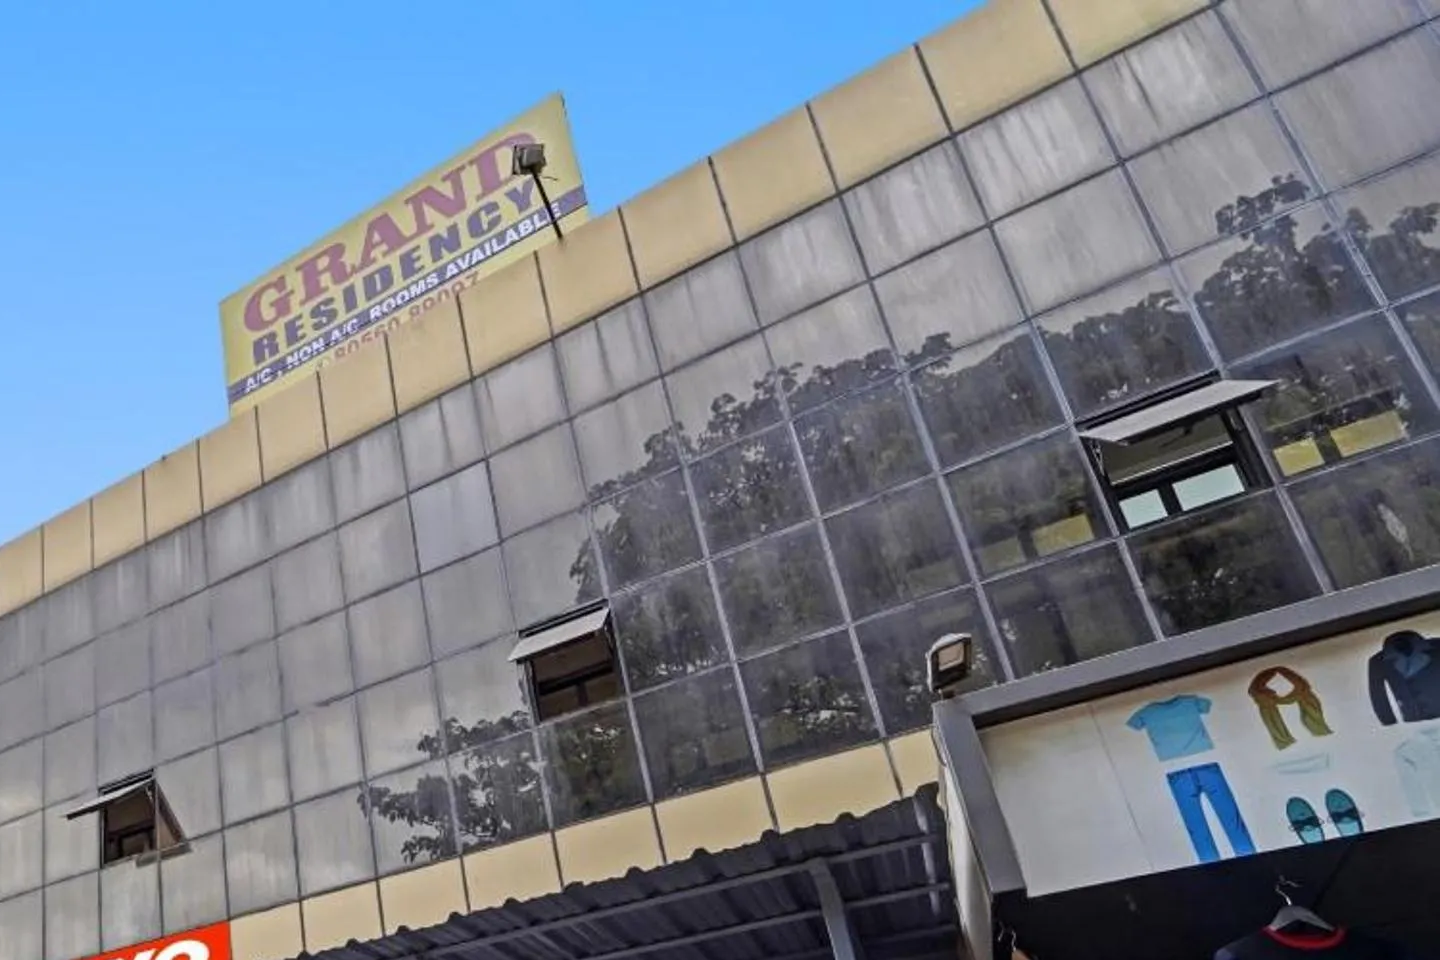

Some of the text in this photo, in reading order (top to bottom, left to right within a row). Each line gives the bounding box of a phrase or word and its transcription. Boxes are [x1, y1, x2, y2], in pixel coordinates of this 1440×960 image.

[243, 132, 537, 333] GRAND
[252, 178, 535, 366] RESIDENCY
[286, 337, 325, 369] NON
[330, 318, 359, 346] A/C
[369, 272, 441, 319] ROOMS
[445, 201, 561, 279] AVAILABLE
